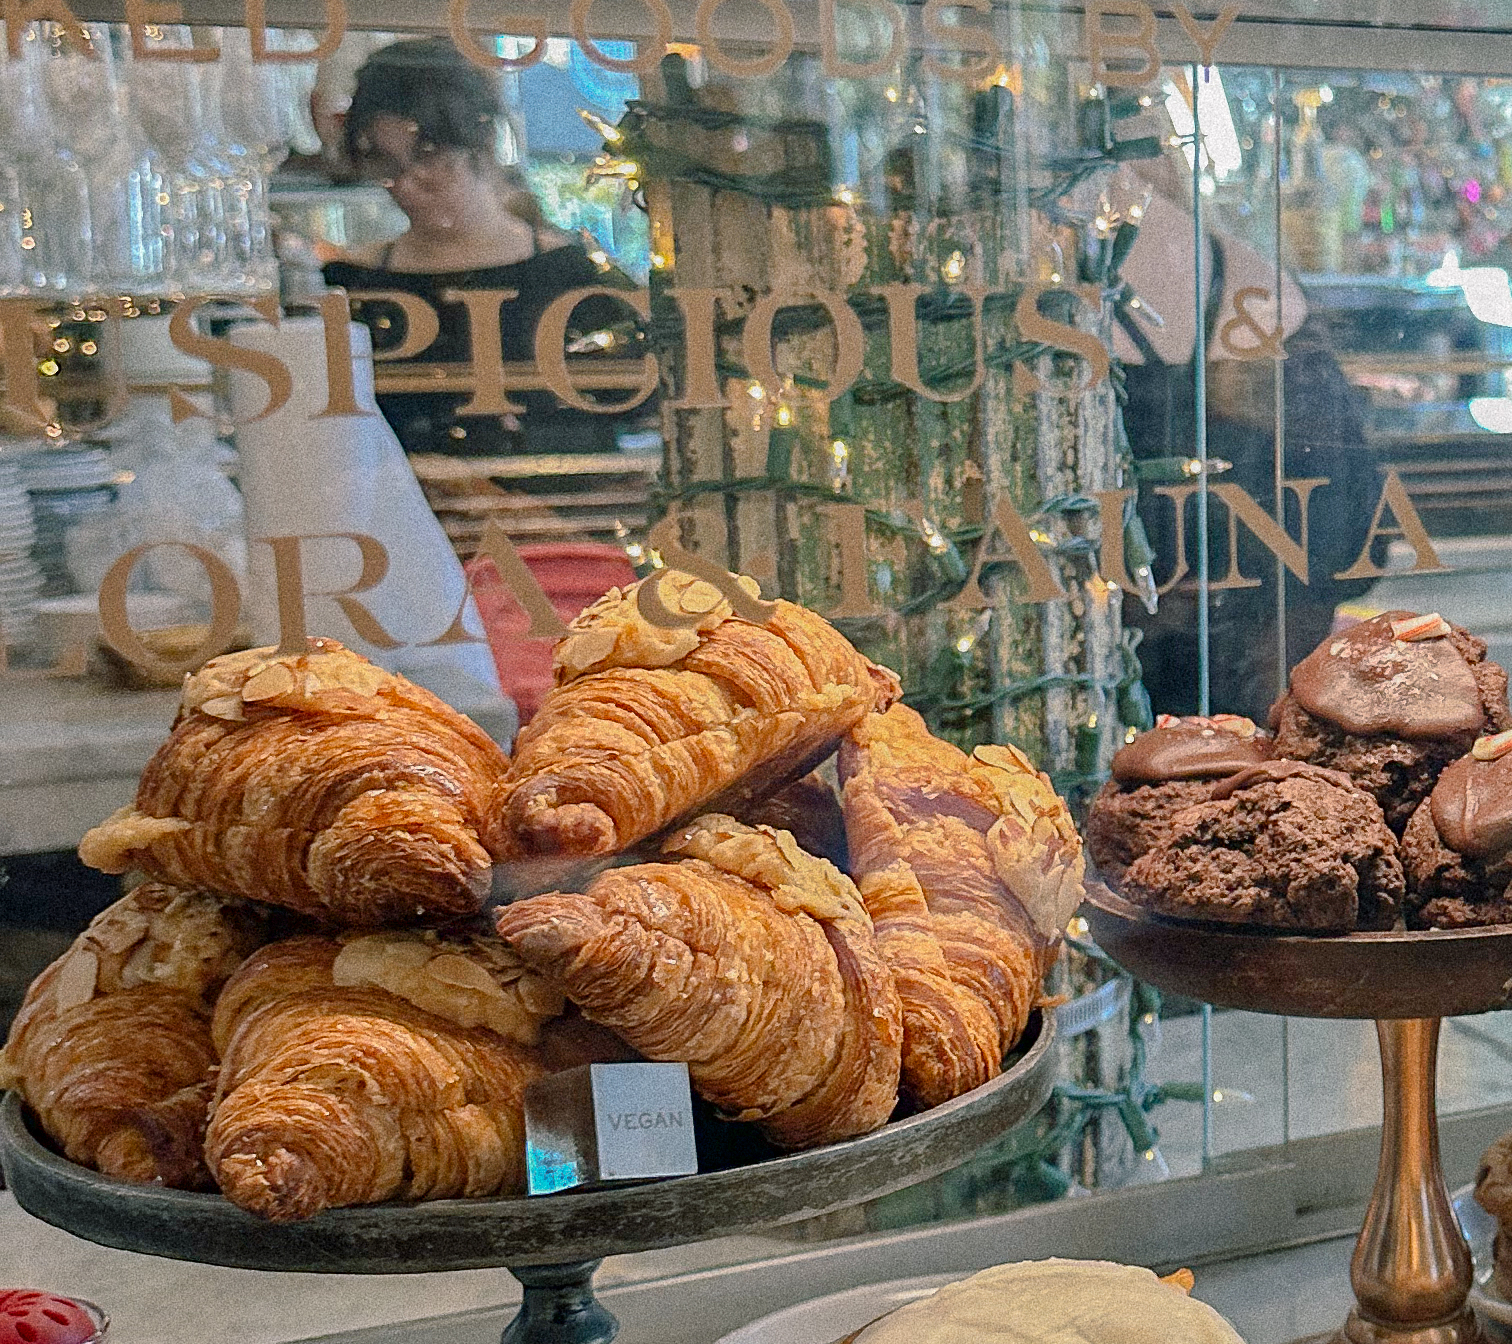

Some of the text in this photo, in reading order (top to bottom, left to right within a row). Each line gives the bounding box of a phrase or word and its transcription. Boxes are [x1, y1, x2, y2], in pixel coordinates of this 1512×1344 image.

[1084, 0, 1241, 87] BY
[1219, 286, 1287, 361] &
[606, 1110, 684, 1132] VEGAN
